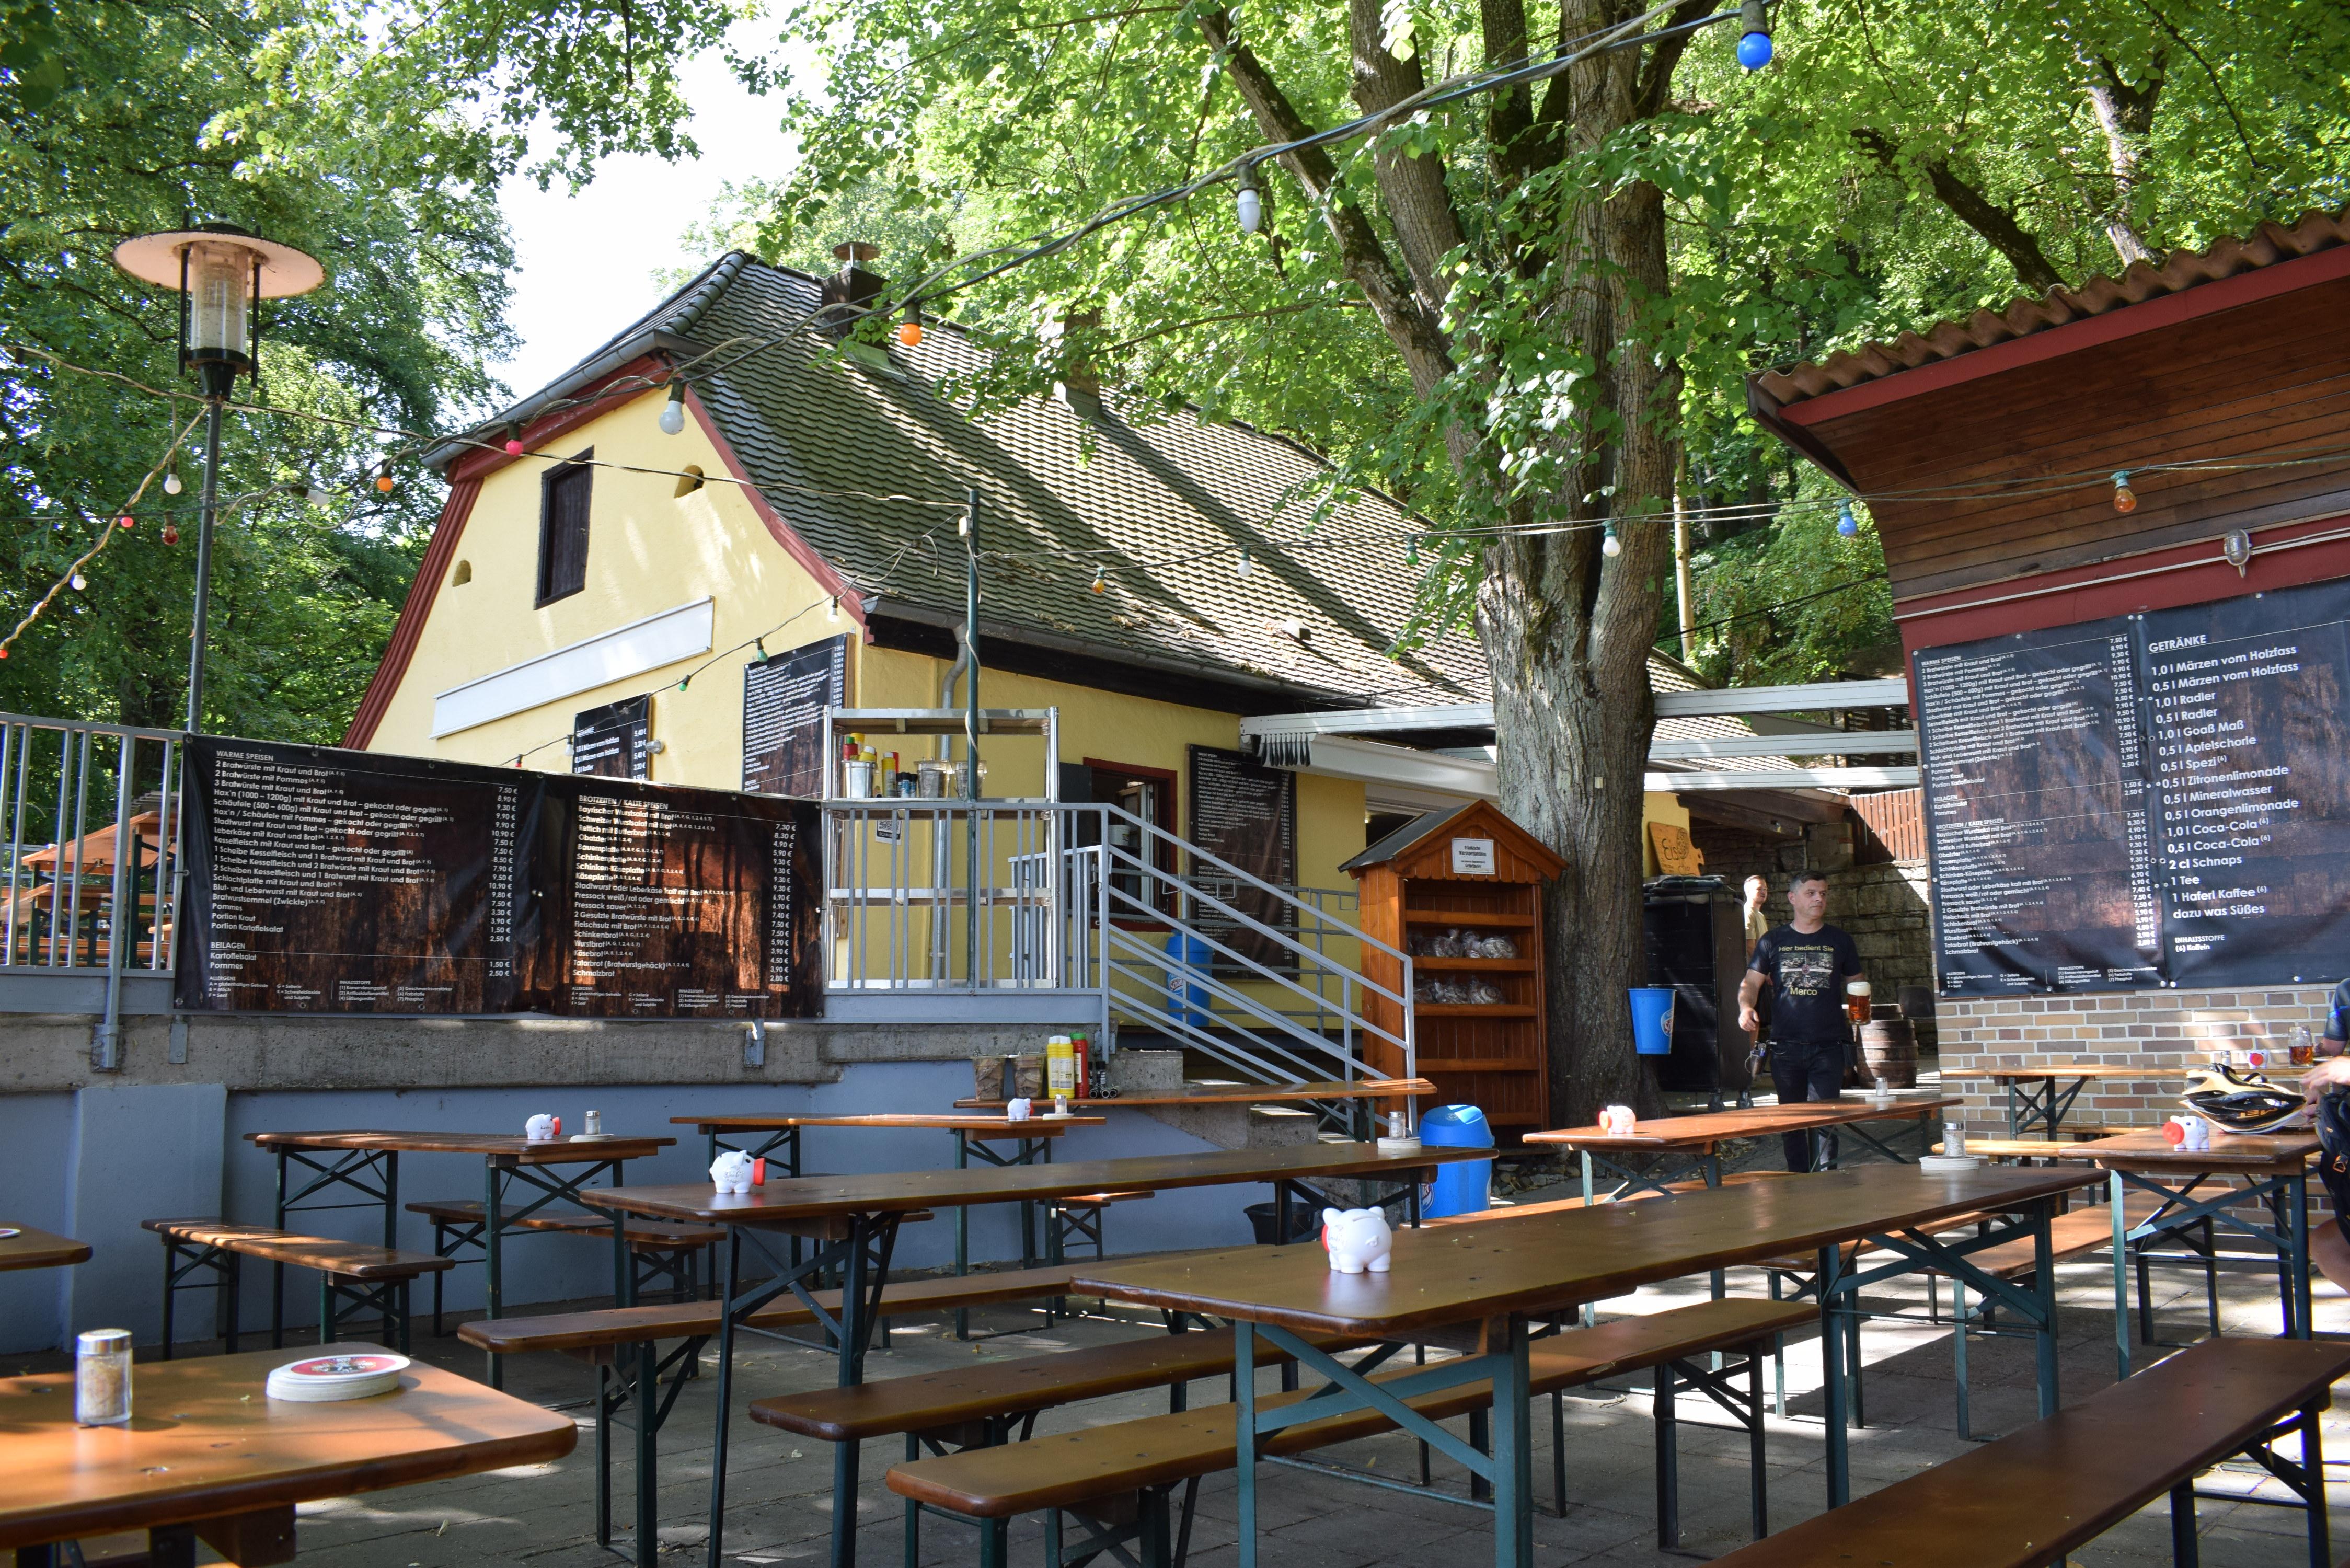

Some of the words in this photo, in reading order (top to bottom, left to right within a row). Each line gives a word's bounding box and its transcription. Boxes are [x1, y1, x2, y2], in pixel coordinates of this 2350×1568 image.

[2149, 635, 2206, 652] GETRÄNKE
[2151, 665, 2167, 676] 1,0
[2176, 659, 2218, 672] Märzen
[2221, 654, 2247, 664] vom
[2250, 647, 2296, 660] Holzfass
[2152, 681, 2169, 691] 0,5
[2178, 675, 2219, 688] Märzen
[2222, 671, 2248, 681] vom
[2251, 663, 2298, 676] Holzfass
[2155, 697, 2171, 708] 1,0
[2180, 692, 2215, 704] Radler
[2156, 713, 2172, 724] 0,5
[2181, 708, 2217, 720] Radler
[2158, 729, 2174, 740] 1,0
[2183, 723, 2215, 736] Goaß
[2218, 720, 2244, 732] Maß
[2159, 745, 2175, 756] 0,5
[2185, 736, 2256, 754] Apfelschorle
[216, 750, 244, 758] WARME
[246, 753, 273, 761] SPEISEN
[222, 761, 261, 770] Bratwürste
[2161, 762, 2176, 772] 0,5
[2186, 756, 2216, 770] Spezi
[2162, 778, 2179, 788] 0,5
[2187, 766, 2289, 785] Zitronenlimonade
[579, 795, 617, 804] BROTZEITEN
[2163, 794, 2180, 804] 0,5
[2190, 786, 2272, 801] Mineralwasser
[2165, 810, 2181, 821] 0,5
[2191, 799, 2298, 817] Orangenlimonade
[2167, 826, 2183, 837] 1,0
[2192, 820, 2257, 834] Coca-Cola
[2259, 817, 2269, 825] (6)
[1662, 838, 1679, 860] Eis
[2168, 843, 2184, 854] 0,5
[2194, 836, 2259, 850] Coca-Cola
[2169, 860, 2176, 869] 2
[2179, 859, 2190, 868] cl
[2193, 857, 2242, 867] Schnaps
[213, 874, 263, 884] Schlachtplatte
[2179, 875, 2199, 884] Tee
[212, 893, 272, 903] Bratwurstsemmel
[273, 897, 307, 906] (Zwickte)
[2182, 890, 2215, 901] Haferl
[2218, 888, 2255, 898] Kaffee
[212, 903, 242, 911] Pommes
[2173, 909, 2201, 918] dazu
[2204, 908, 2227, 916] was
[2230, 904, 2264, 915] Süßes
[239, 924, 283, 932] Kartoffelsalat
[2174, 935, 2225, 943] INHALTSSTOFFE
[573, 969, 614, 977] Schmalzbrot
[604, 961, 665, 970] (Bratwurstgehäck)
